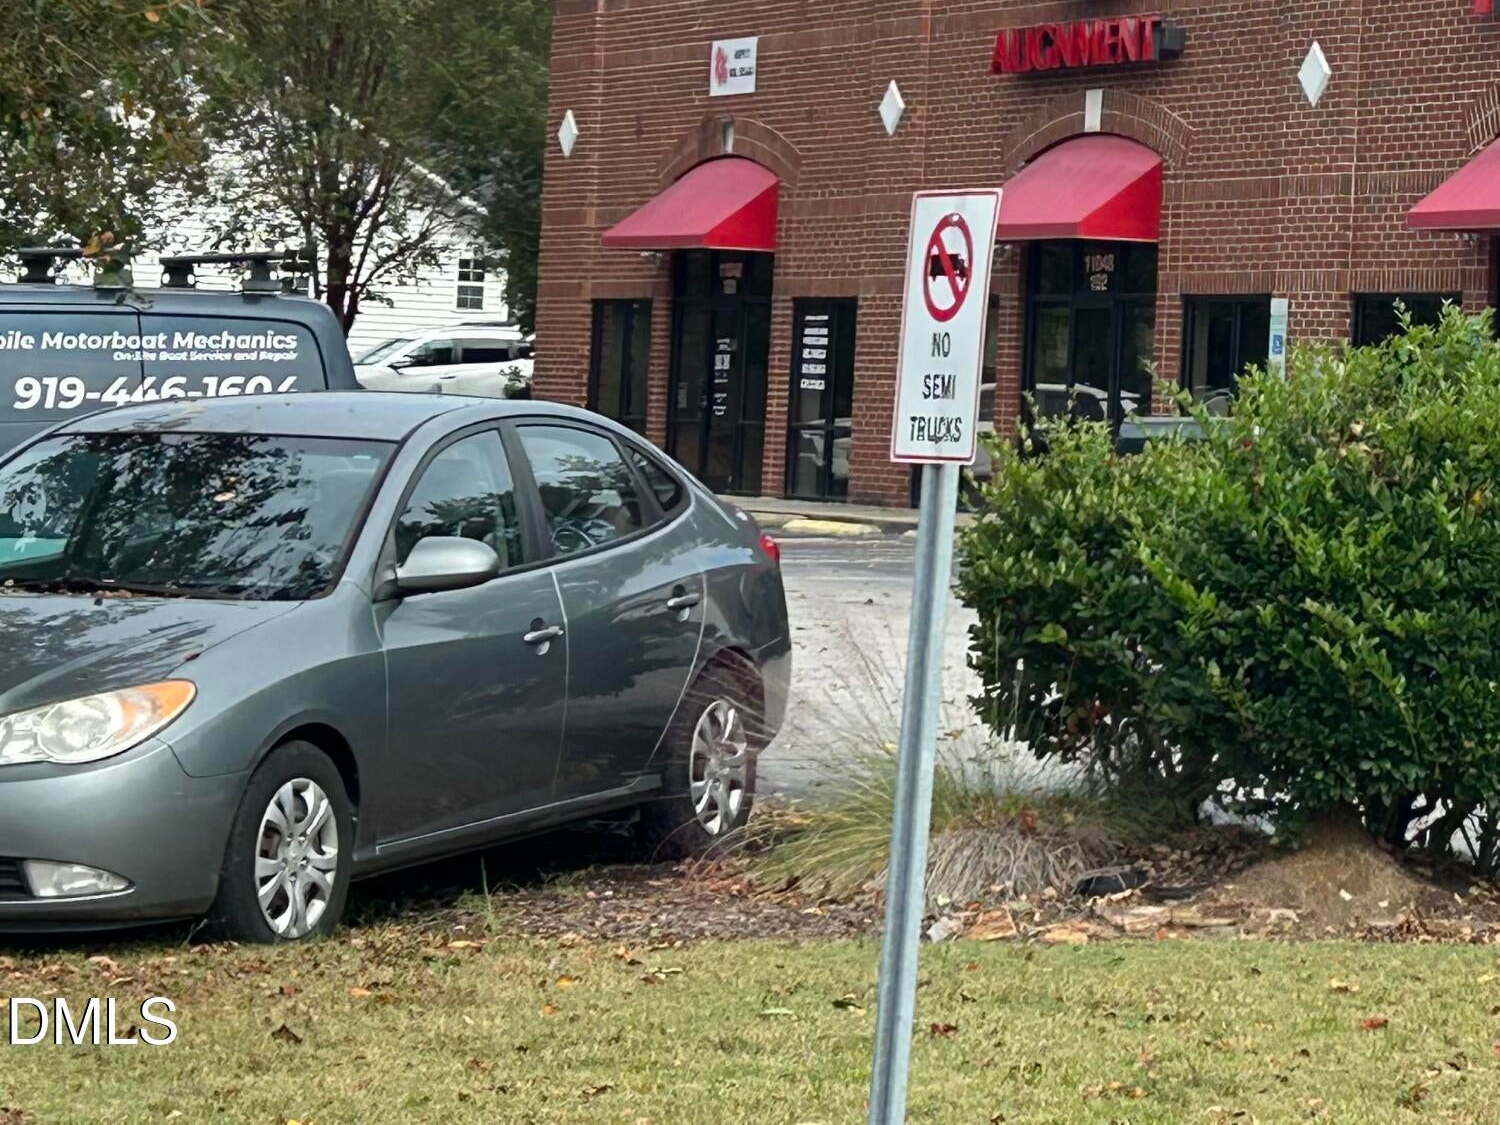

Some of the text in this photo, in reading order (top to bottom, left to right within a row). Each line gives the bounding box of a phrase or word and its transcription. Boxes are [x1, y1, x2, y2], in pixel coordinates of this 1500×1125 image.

[990, 12, 1162, 75] ALIGNMENT
[41, 331, 167, 350] Motorboat
[173, 330, 298, 350] Mechanics
[931, 331, 951, 358] NO
[233, 351, 257, 362] and
[922, 373, 957, 400] SEMI
[910, 416, 963, 444] TRUCKS
